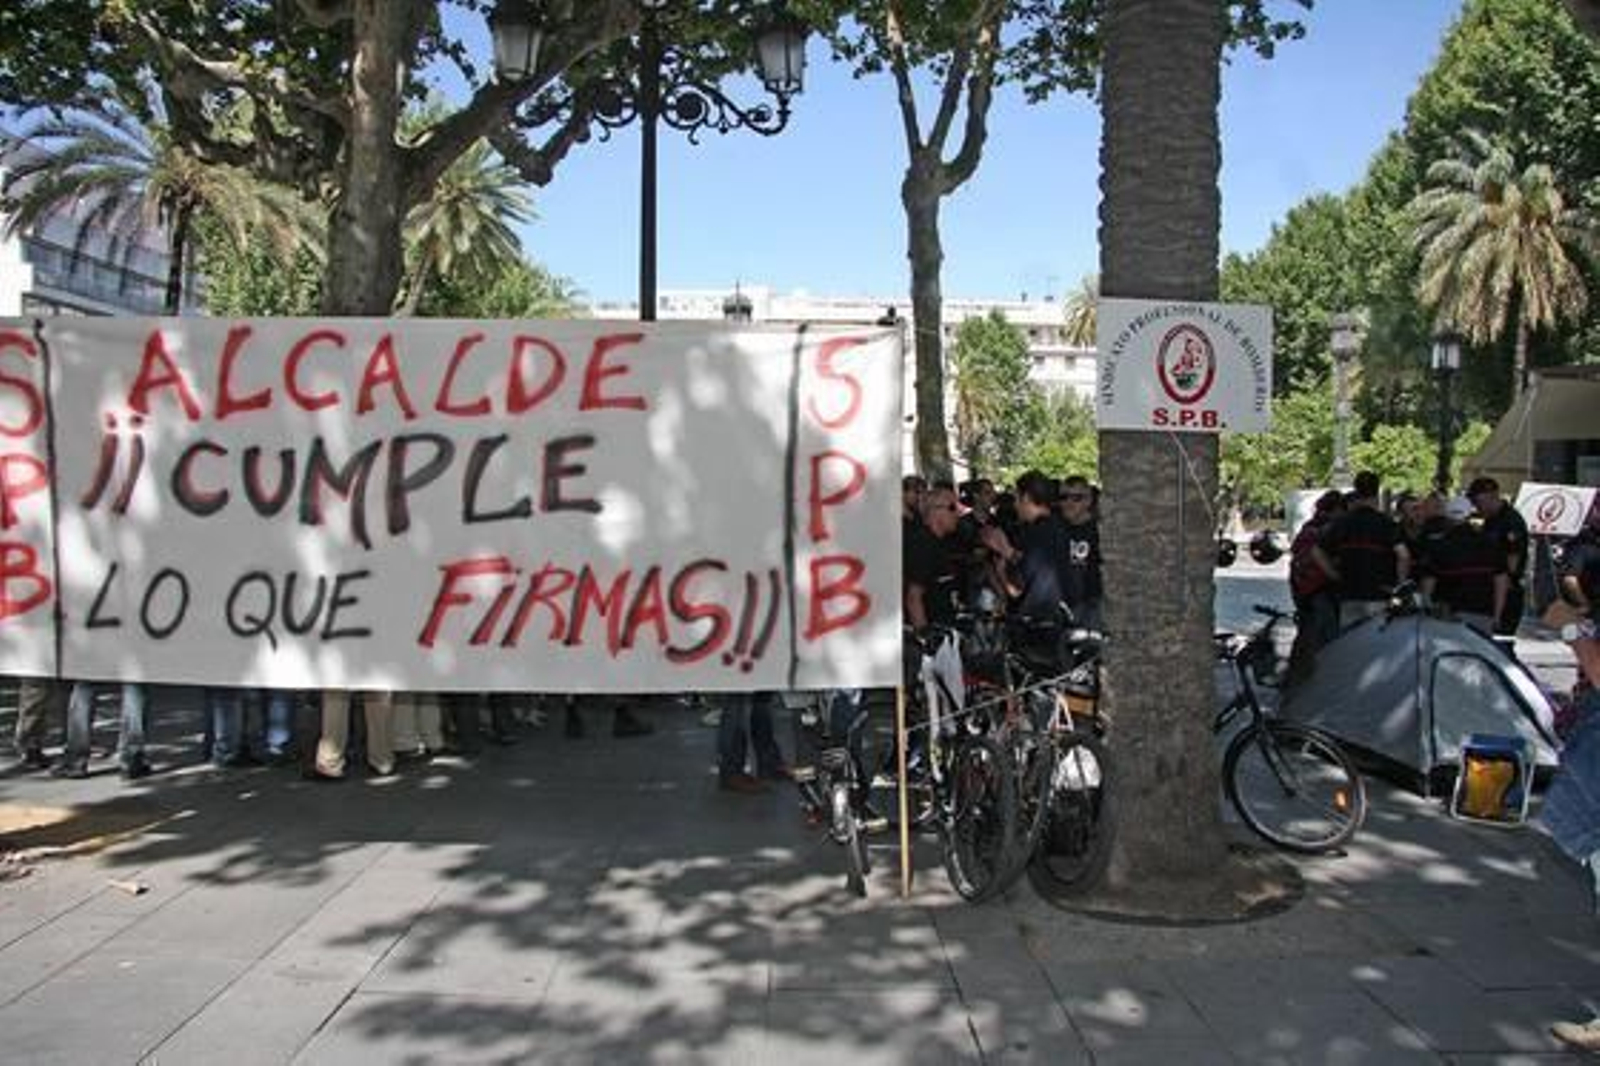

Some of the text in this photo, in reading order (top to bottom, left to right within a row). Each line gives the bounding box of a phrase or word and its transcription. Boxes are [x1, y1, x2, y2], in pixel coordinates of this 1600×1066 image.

[127, 325, 648, 421] ALCALDE
[1152, 407, 1227, 428] S.P.B.
[86, 561, 190, 641] LO
[225, 568, 372, 651] QUE
